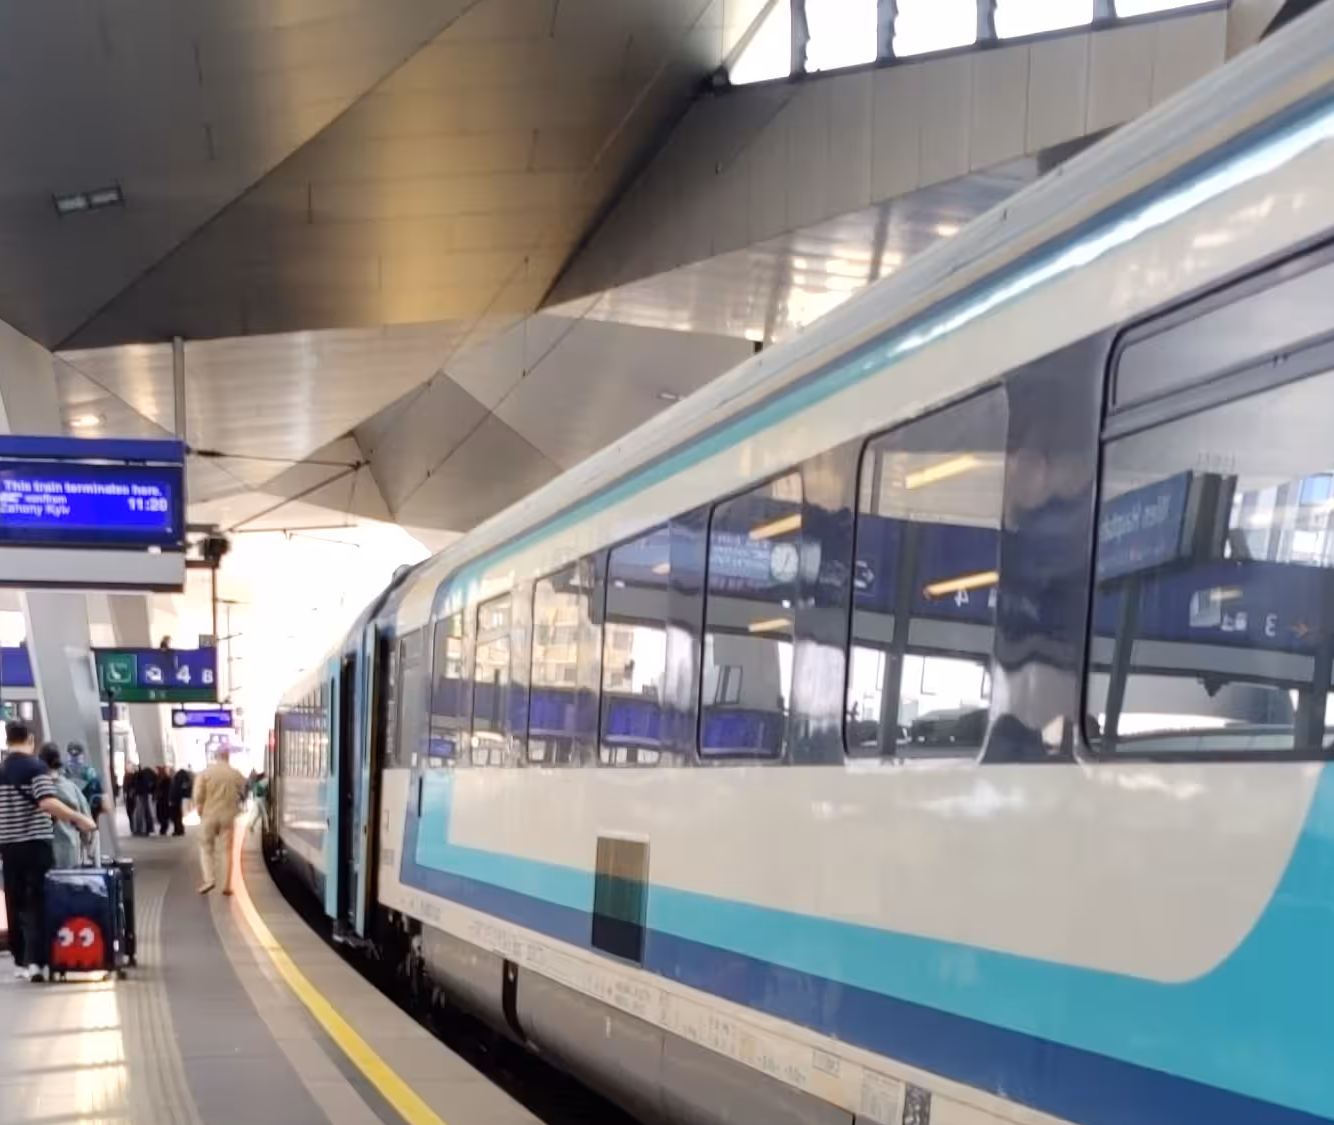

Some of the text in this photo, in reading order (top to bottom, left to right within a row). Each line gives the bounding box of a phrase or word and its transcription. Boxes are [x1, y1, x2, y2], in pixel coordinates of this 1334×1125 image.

[3, 479, 31, 493] This
[33, 480, 63, 494] train
[176, 664, 192, 684] 4
